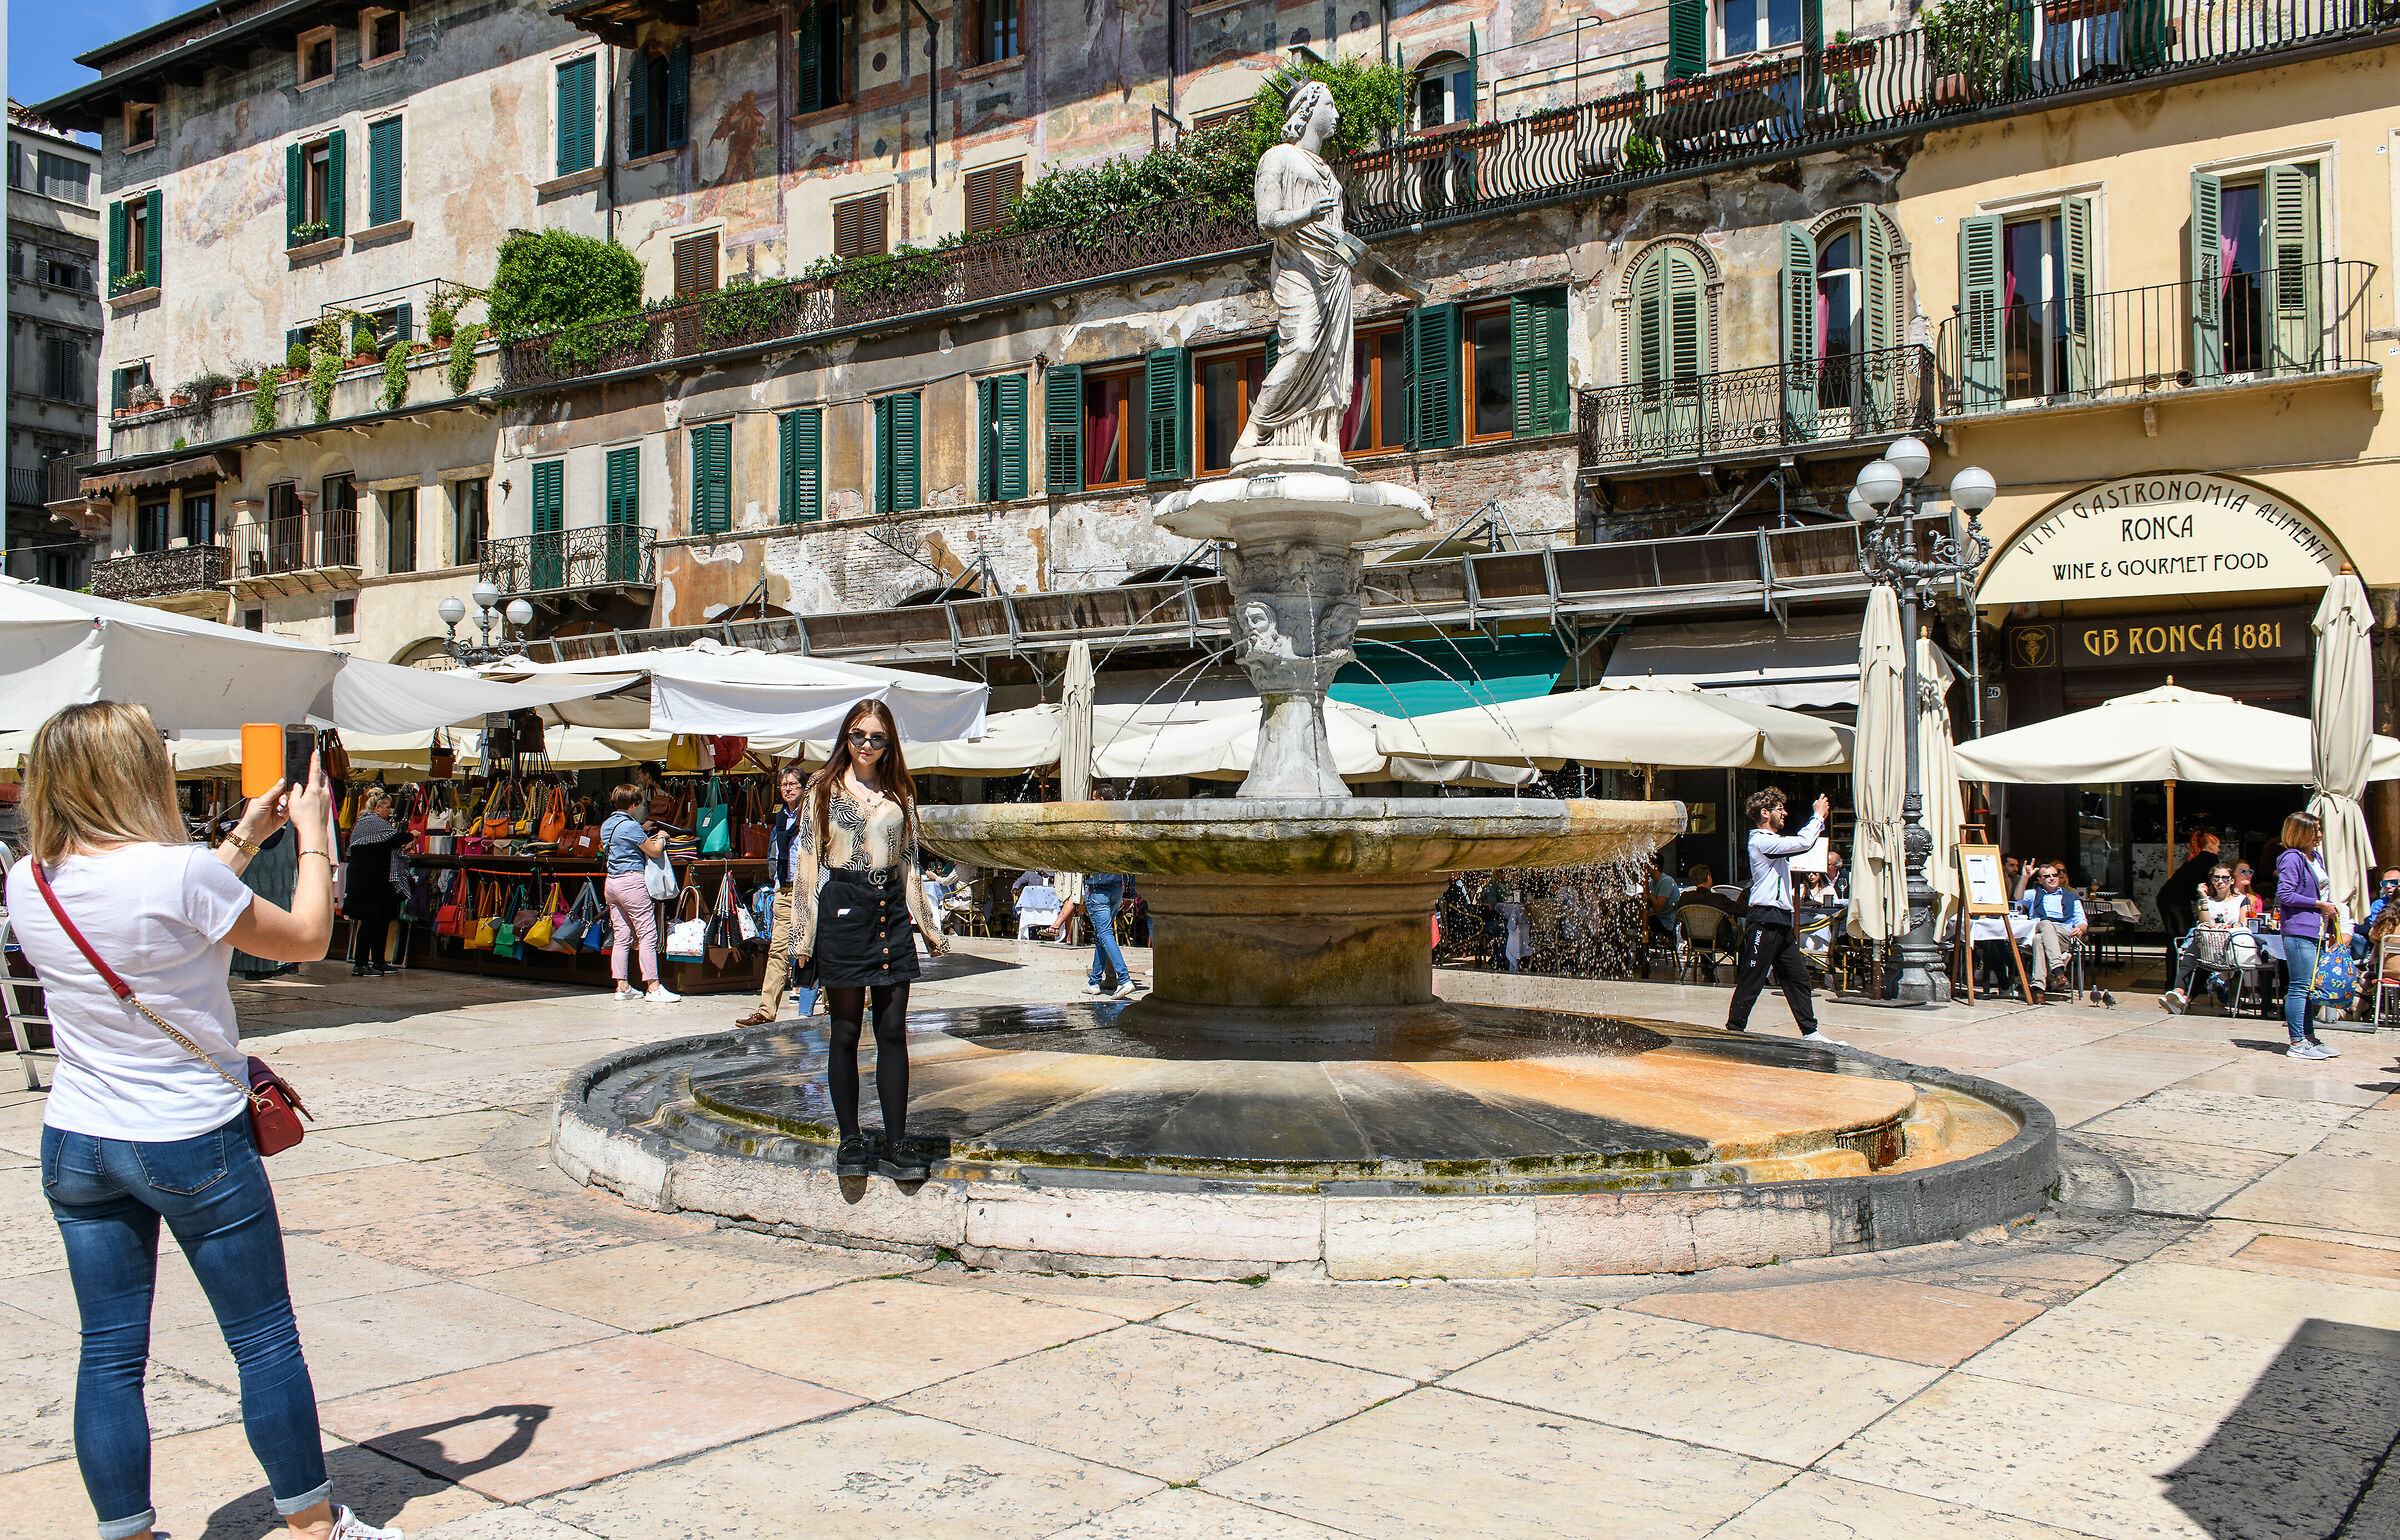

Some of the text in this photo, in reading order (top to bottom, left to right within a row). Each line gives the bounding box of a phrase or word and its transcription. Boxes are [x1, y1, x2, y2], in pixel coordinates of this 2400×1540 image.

[2018, 480, 2333, 564] VINI GASTRONOMIA ALIMENTI
[2121, 514, 2193, 542] RONCA
[2052, 552, 2269, 581] WINE & GOURMET FOOD
[2083, 621, 2281, 657] GB RONCA 1881
